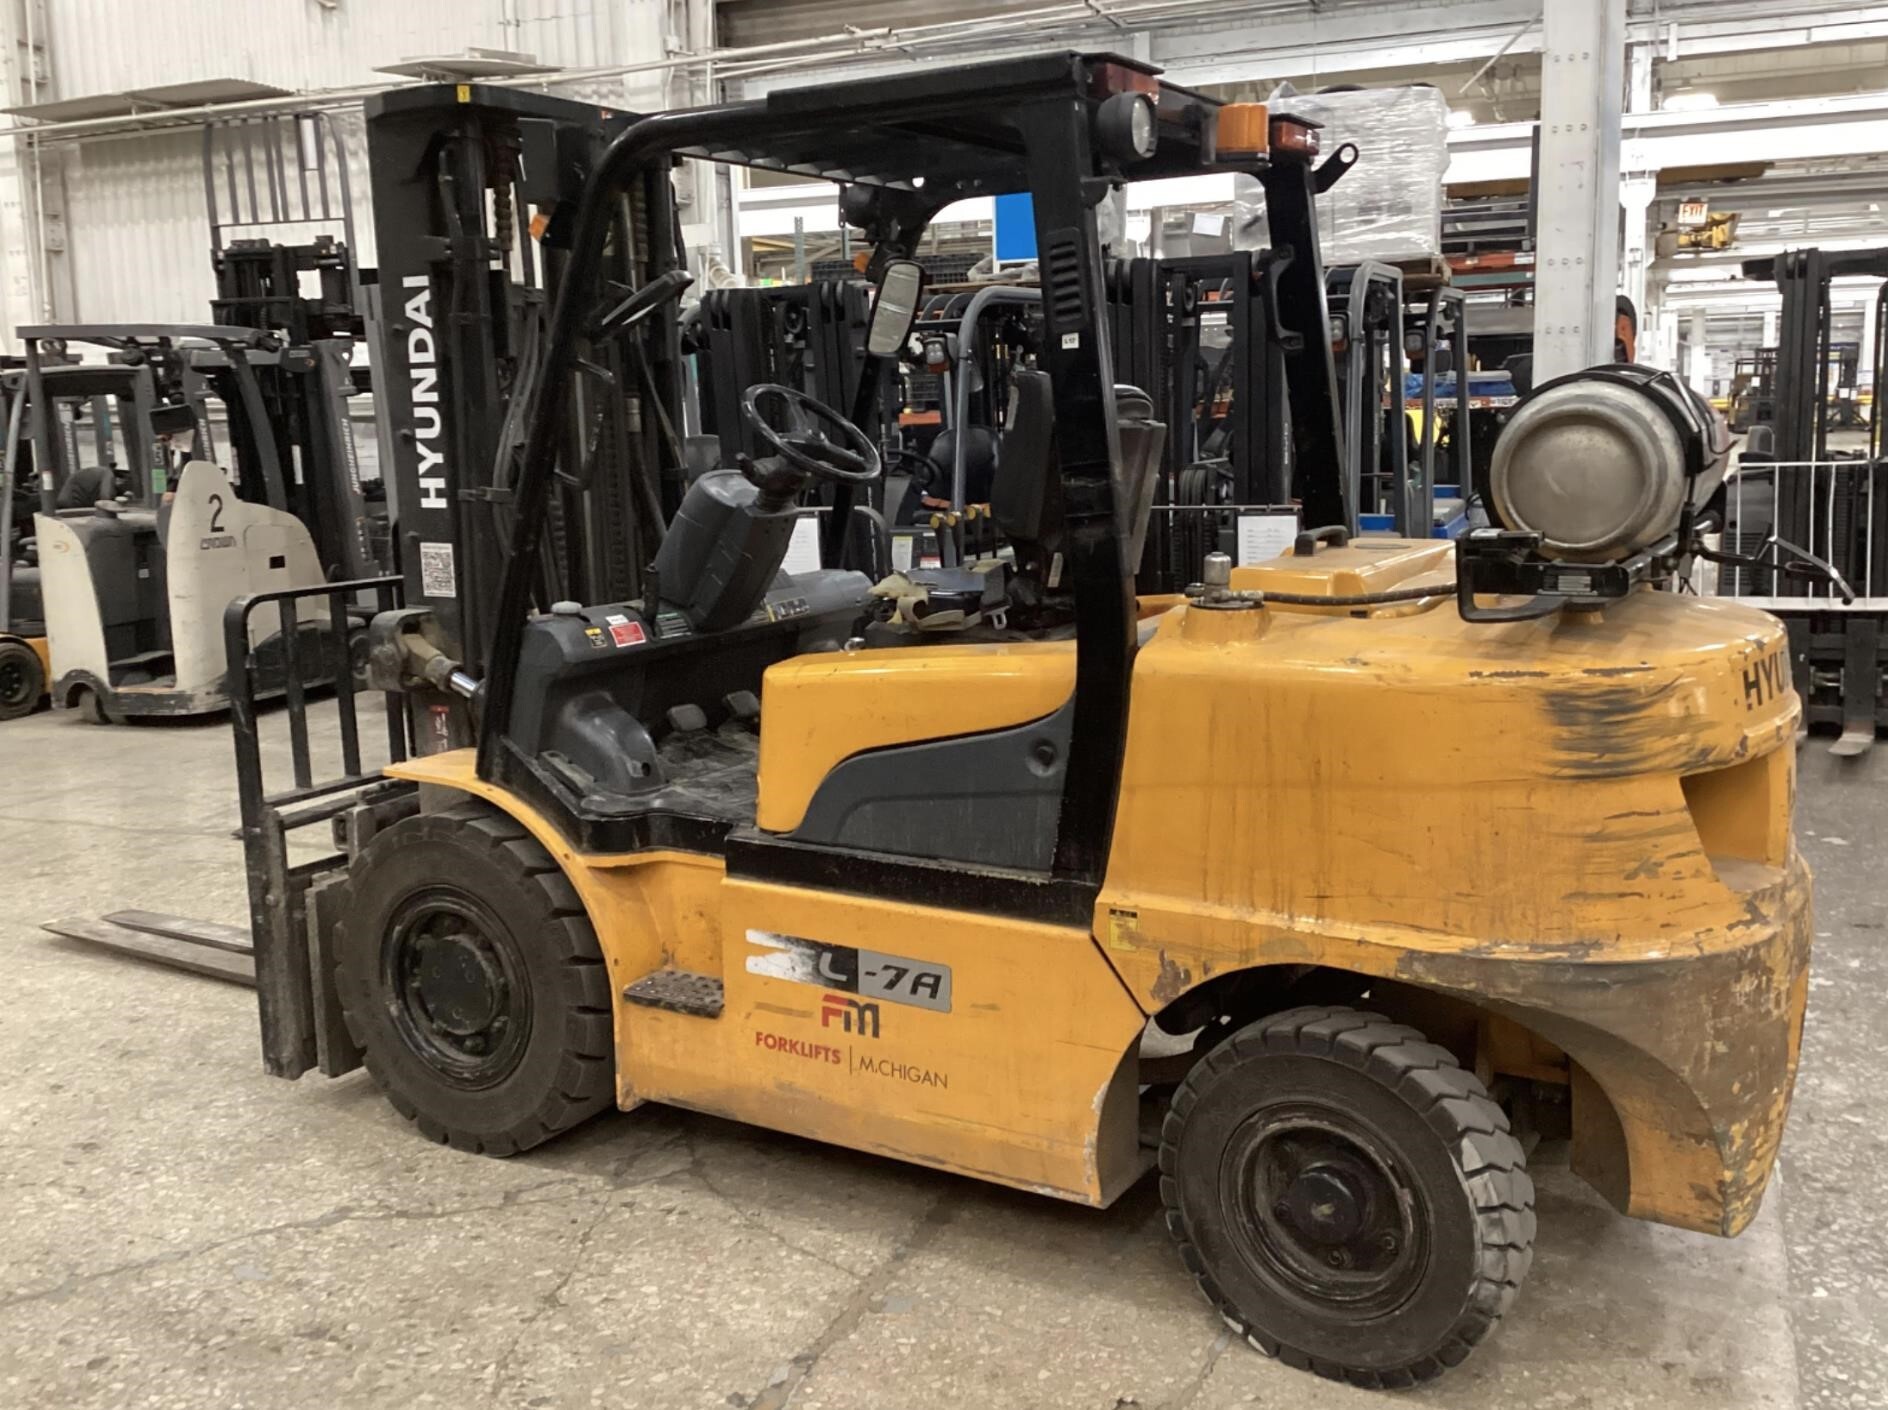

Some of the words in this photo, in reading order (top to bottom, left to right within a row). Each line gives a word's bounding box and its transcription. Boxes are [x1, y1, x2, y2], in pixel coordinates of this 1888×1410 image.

[1683, 203, 1705, 216] EXIT
[402, 275, 447, 509] HYUNDAI
[208, 493, 224, 533] 2
[821, 994, 880, 1039] FM
[755, 1031, 841, 1065] FORKLIFTS
[859, 1055, 948, 1089] MCHIGAN
